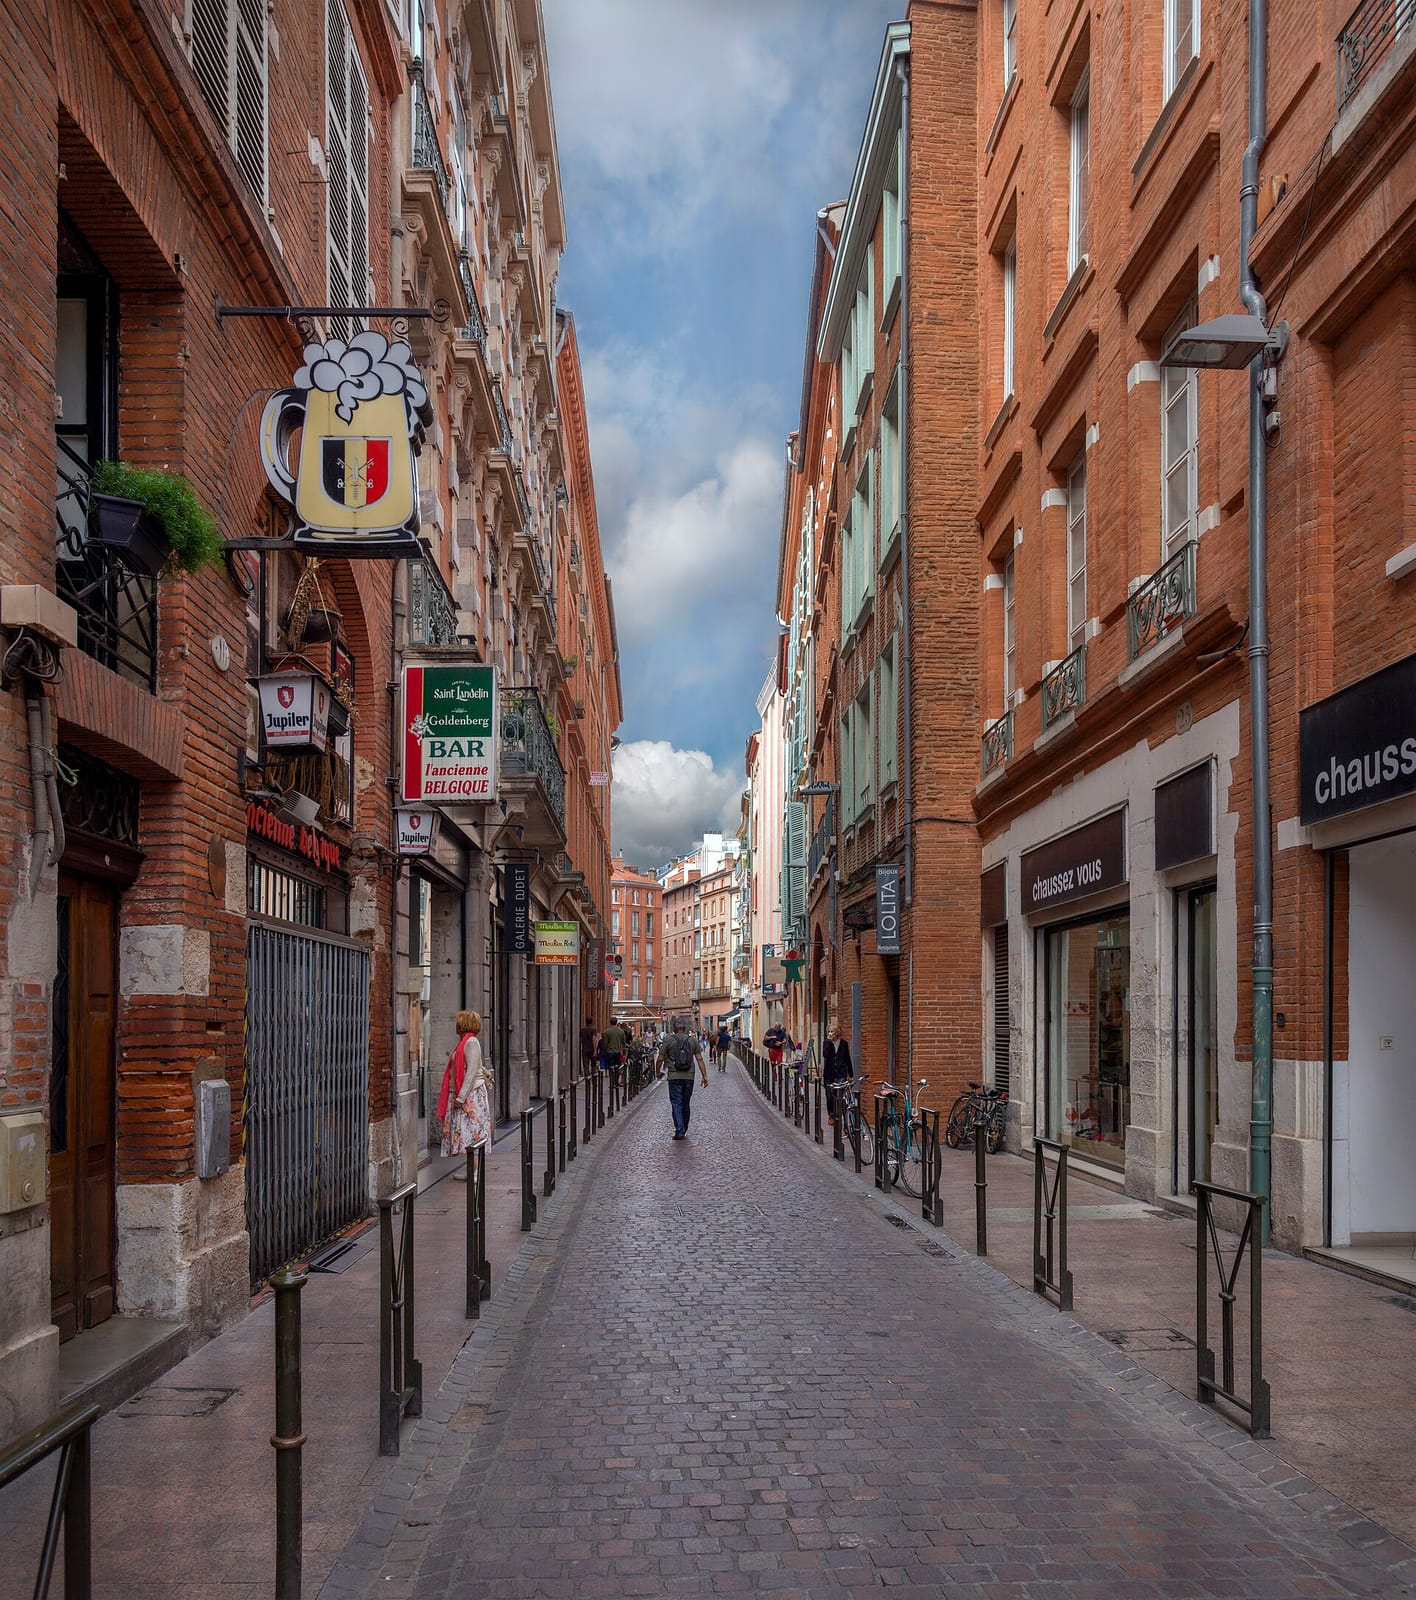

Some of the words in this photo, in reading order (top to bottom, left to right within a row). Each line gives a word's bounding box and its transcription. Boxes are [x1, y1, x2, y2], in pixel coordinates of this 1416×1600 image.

[434, 689, 454, 699] Saint
[456, 685, 489, 701] Landelin
[266, 712, 309, 731] Jupiler
[429, 715, 490, 728] Goldenberg
[429, 741, 485, 758] BAR
[425, 764, 488, 777] l'ancienne
[1315, 738, 1416, 804] chauss
[424, 780, 489, 795] BELGIQUE
[400, 832, 429, 844] Jupiler
[1033, 876, 1074, 901] chaussez
[1076, 859, 1102, 886] vous
[881, 880, 896, 939] LOLITA
[515, 906, 526, 949] GALERIE
